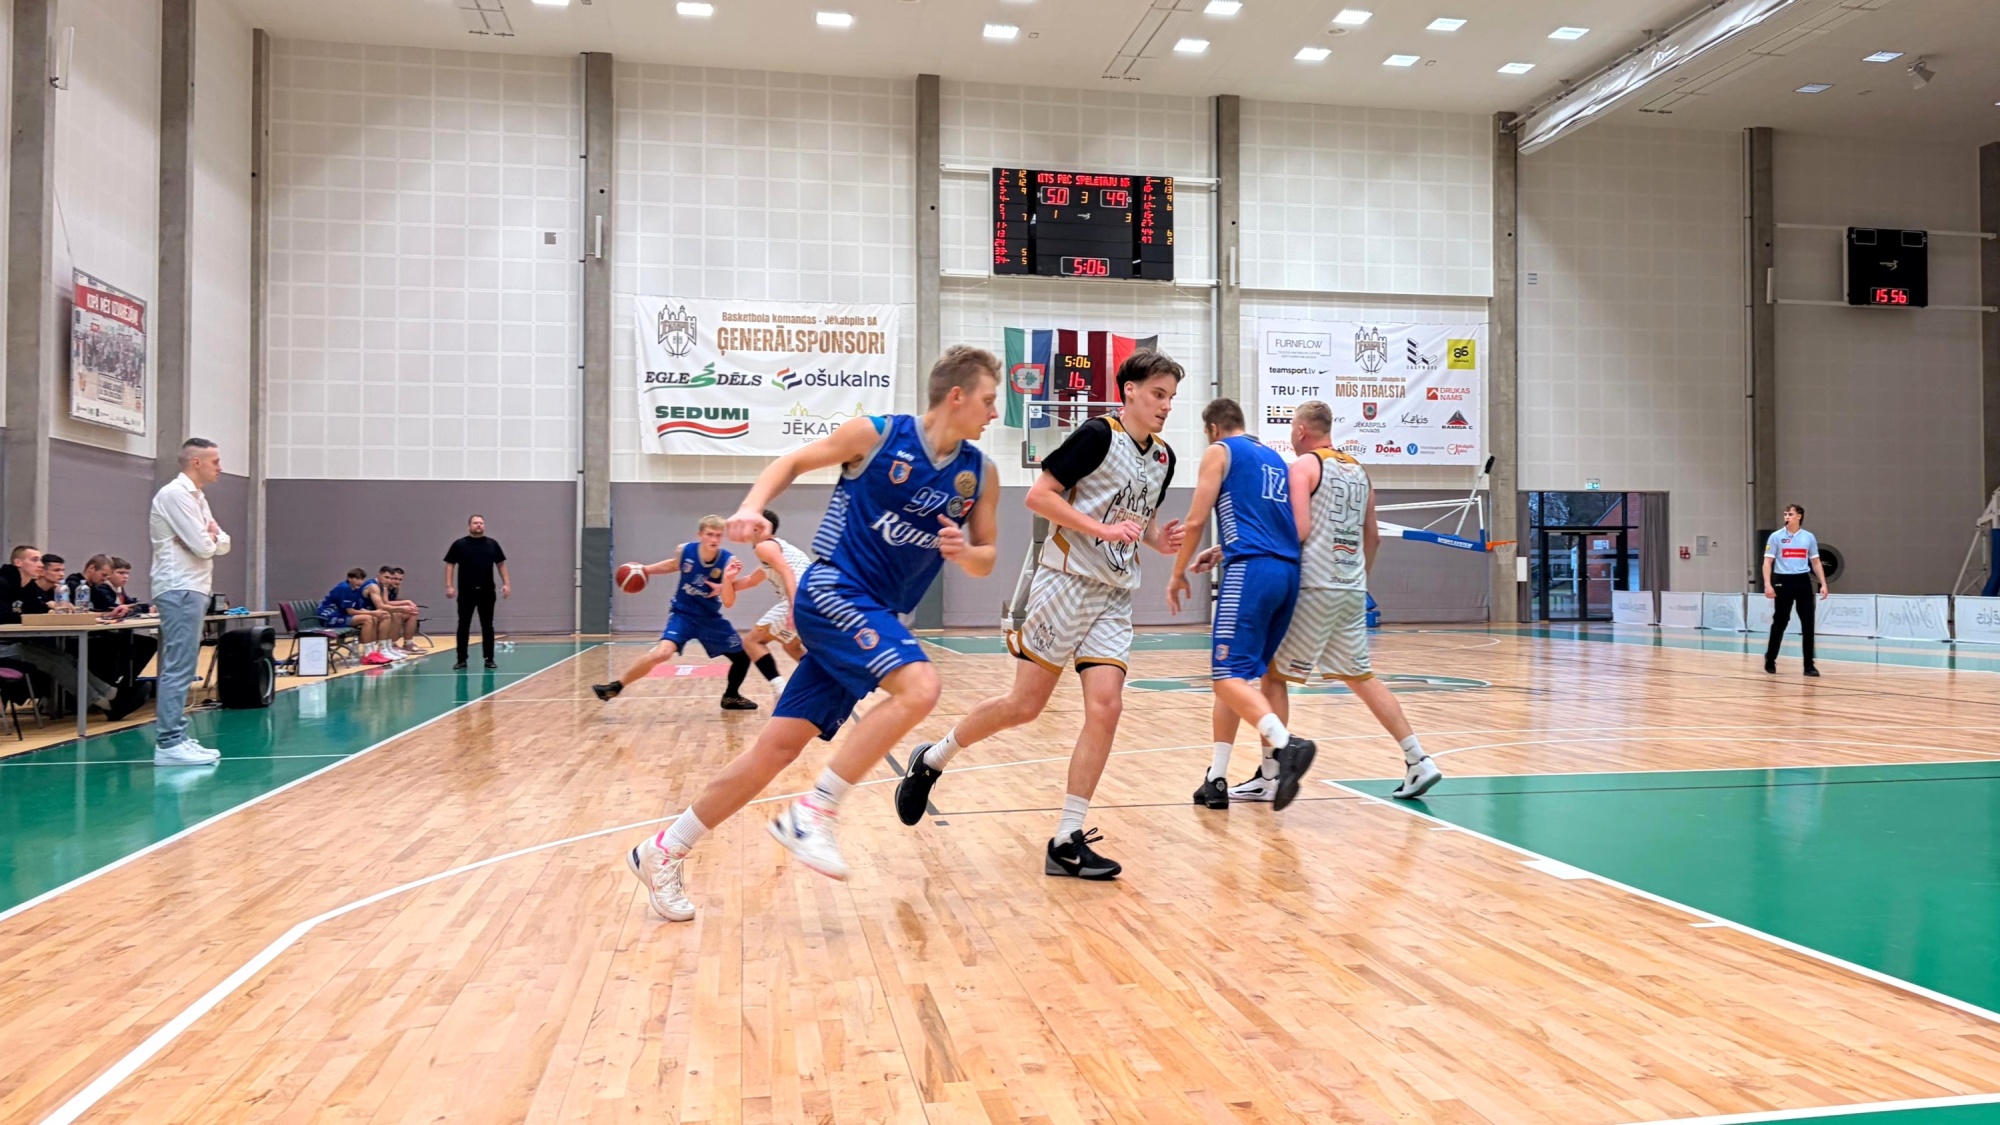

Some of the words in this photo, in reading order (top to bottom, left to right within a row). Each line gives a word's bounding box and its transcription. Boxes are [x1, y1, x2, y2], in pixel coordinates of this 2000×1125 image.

[1047, 188, 1067, 204] 50
[1080, 191, 1088, 204] 3
[1106, 191, 1127, 206] 49
[1125, 212, 1132, 223] 3
[1073, 258, 1106, 276] 5:06
[722, 311, 770, 323] Basketbola
[772, 313, 817, 325] komandas
[824, 314, 865, 327] Jēkabpils
[866, 316, 878, 326] BA
[717, 325, 886, 356] ĢENERĀLSPONSORI
[1453, 345, 1469, 359] 86
[1065, 355, 1091, 369] 5:06
[804, 368, 890, 388] ošukalns
[1269, 366, 1316, 375] teamsport.lv
[716, 372, 762, 387] DĒLS
[1069, 371, 1086, 390] 16
[1335, 381, 1359, 397] MŪS
[1360, 384, 1406, 399] ATBALSTA
[655, 405, 749, 420] SEDUMI
[1375, 443, 1401, 454] Dona
[1136, 456, 1147, 484] 2
[1261, 463, 1288, 503] 12
[902, 486, 950, 518] 97
[1330, 477, 1366, 528] 34
